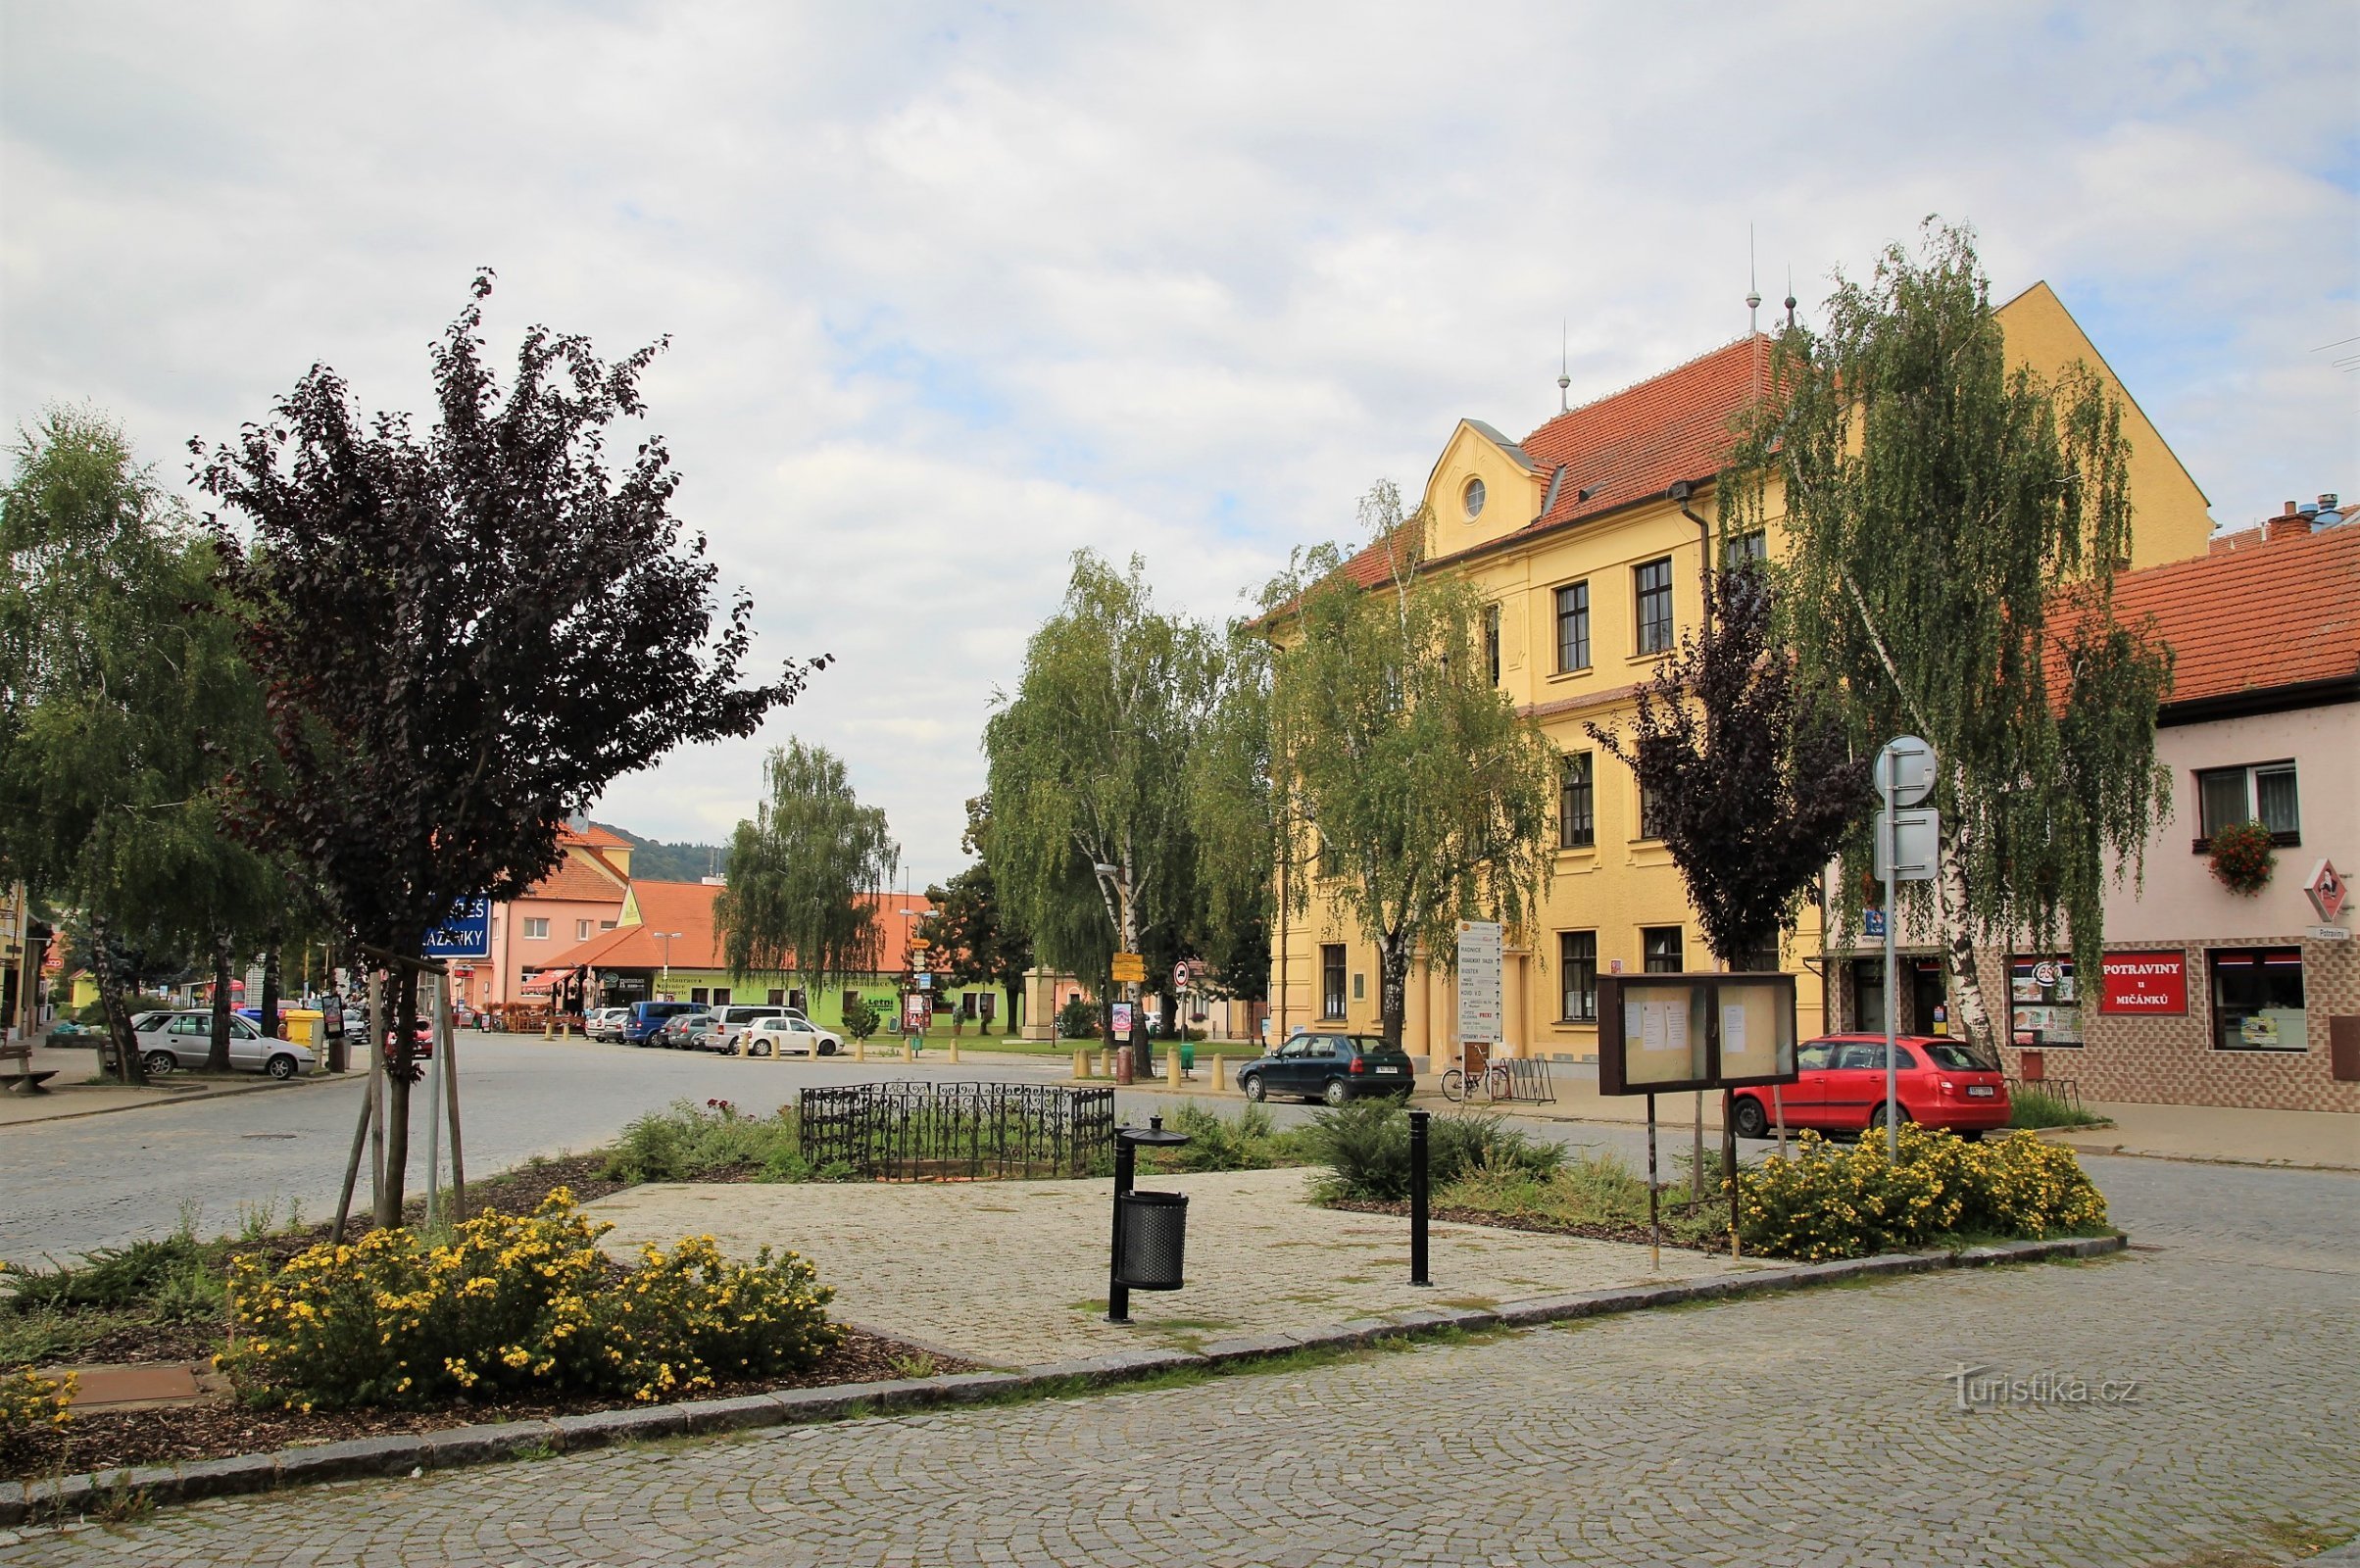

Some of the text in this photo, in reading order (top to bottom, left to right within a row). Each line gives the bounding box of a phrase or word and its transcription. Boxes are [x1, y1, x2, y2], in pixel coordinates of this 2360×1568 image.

[2320, 929, 2343, 939] Potraviny
[2102, 963, 2180, 975] POTRAVINY
[2116, 994, 2168, 1004] MIČÁNKŮ
